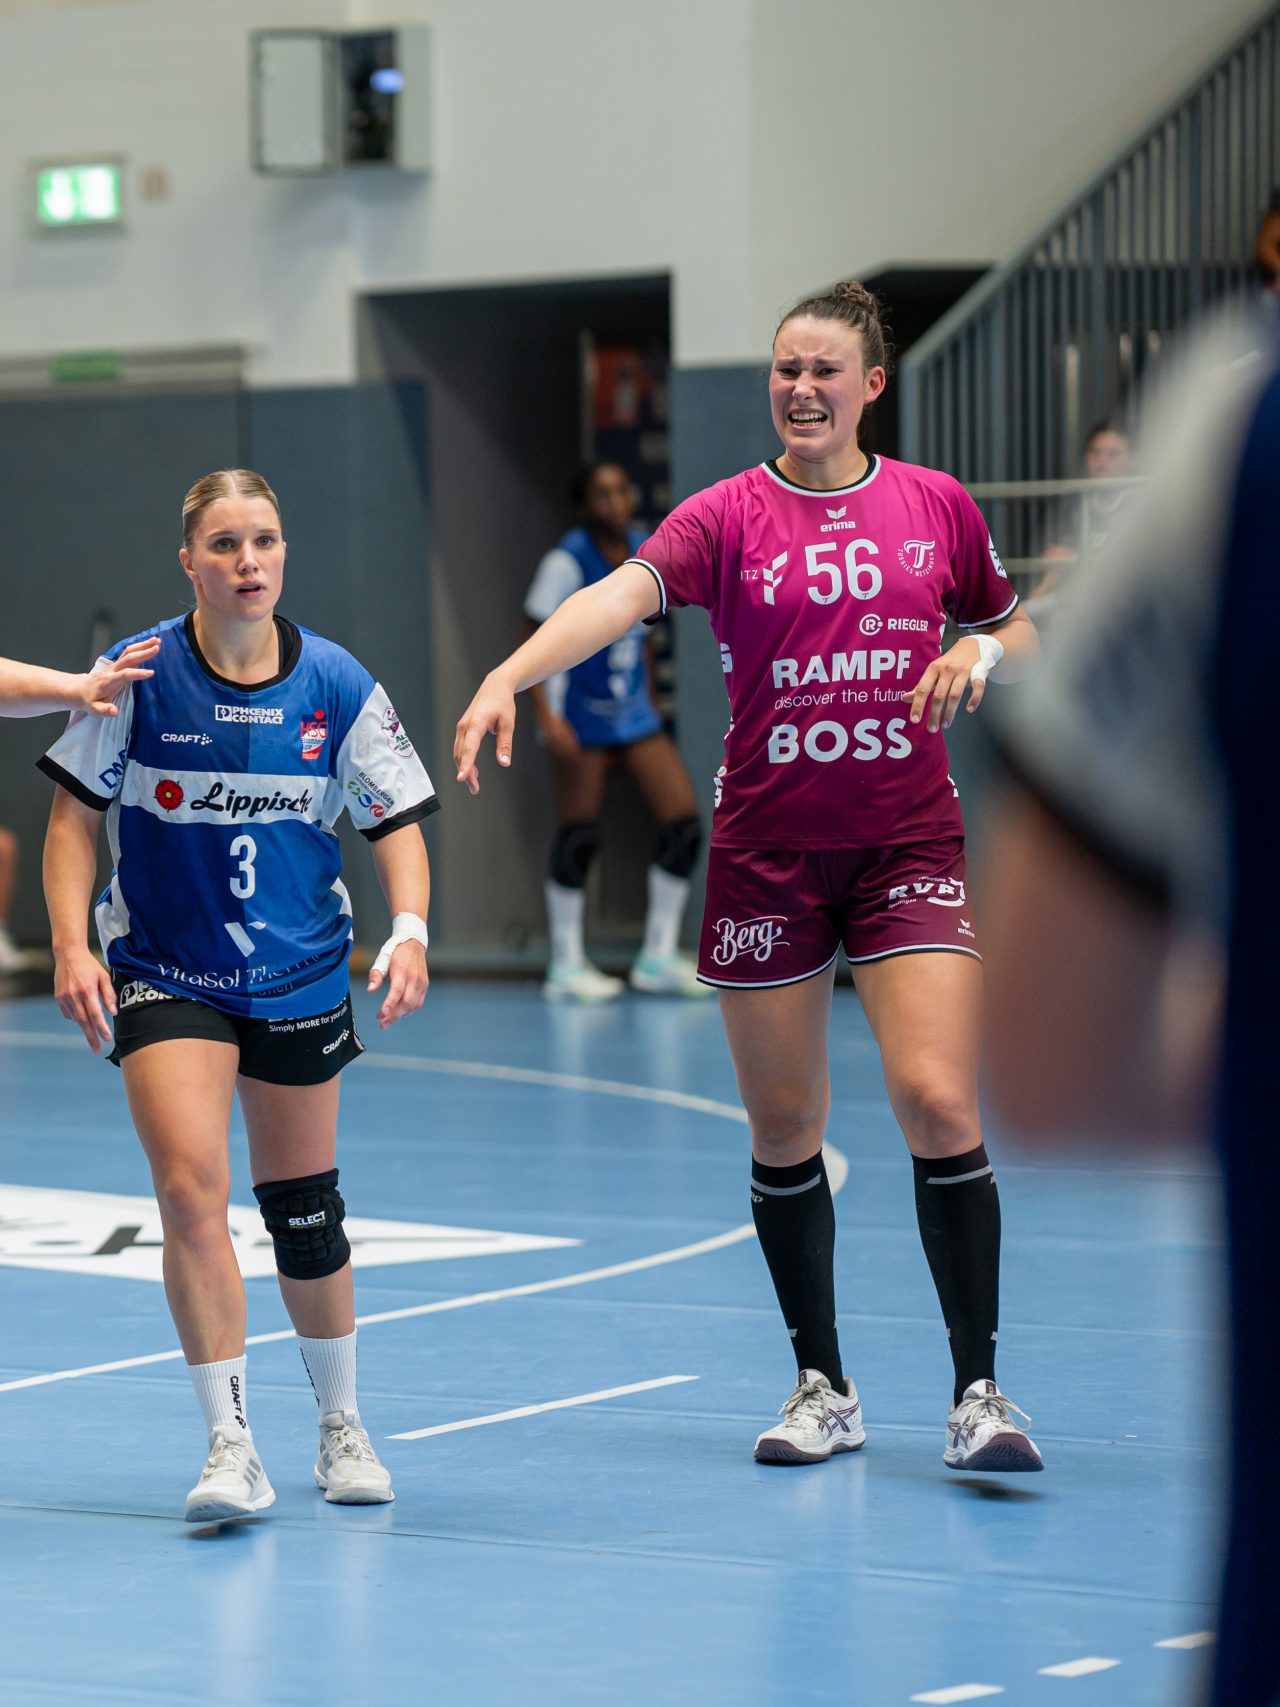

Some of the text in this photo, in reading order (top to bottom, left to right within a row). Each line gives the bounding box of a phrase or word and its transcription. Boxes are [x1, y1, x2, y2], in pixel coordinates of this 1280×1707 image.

[820, 520, 856, 533] erima
[805, 538, 882, 605] 56
[887, 618, 929, 633] RIEGLER
[772, 649, 912, 689] RAMPF
[774, 690, 837, 711] discover
[841, 688, 868, 703] the
[232, 714, 284, 725] CONTACT
[300, 721, 328, 738] HSG
[161, 733, 201, 744] CRAFT
[768, 717, 913, 764] BOSS
[358, 771, 395, 806] BLOMBERGER
[229, 834, 256, 898] 3
[713, 917, 783, 966] Berg
[157, 964, 240, 989] VitaSol
[269, 1024, 295, 1033] Simply
[296, 1018, 320, 1030] MORE
[321, 1016, 330, 1025] for
[288, 1210, 325, 1226] SELECT
[230, 1375, 243, 1415] CRAFT
